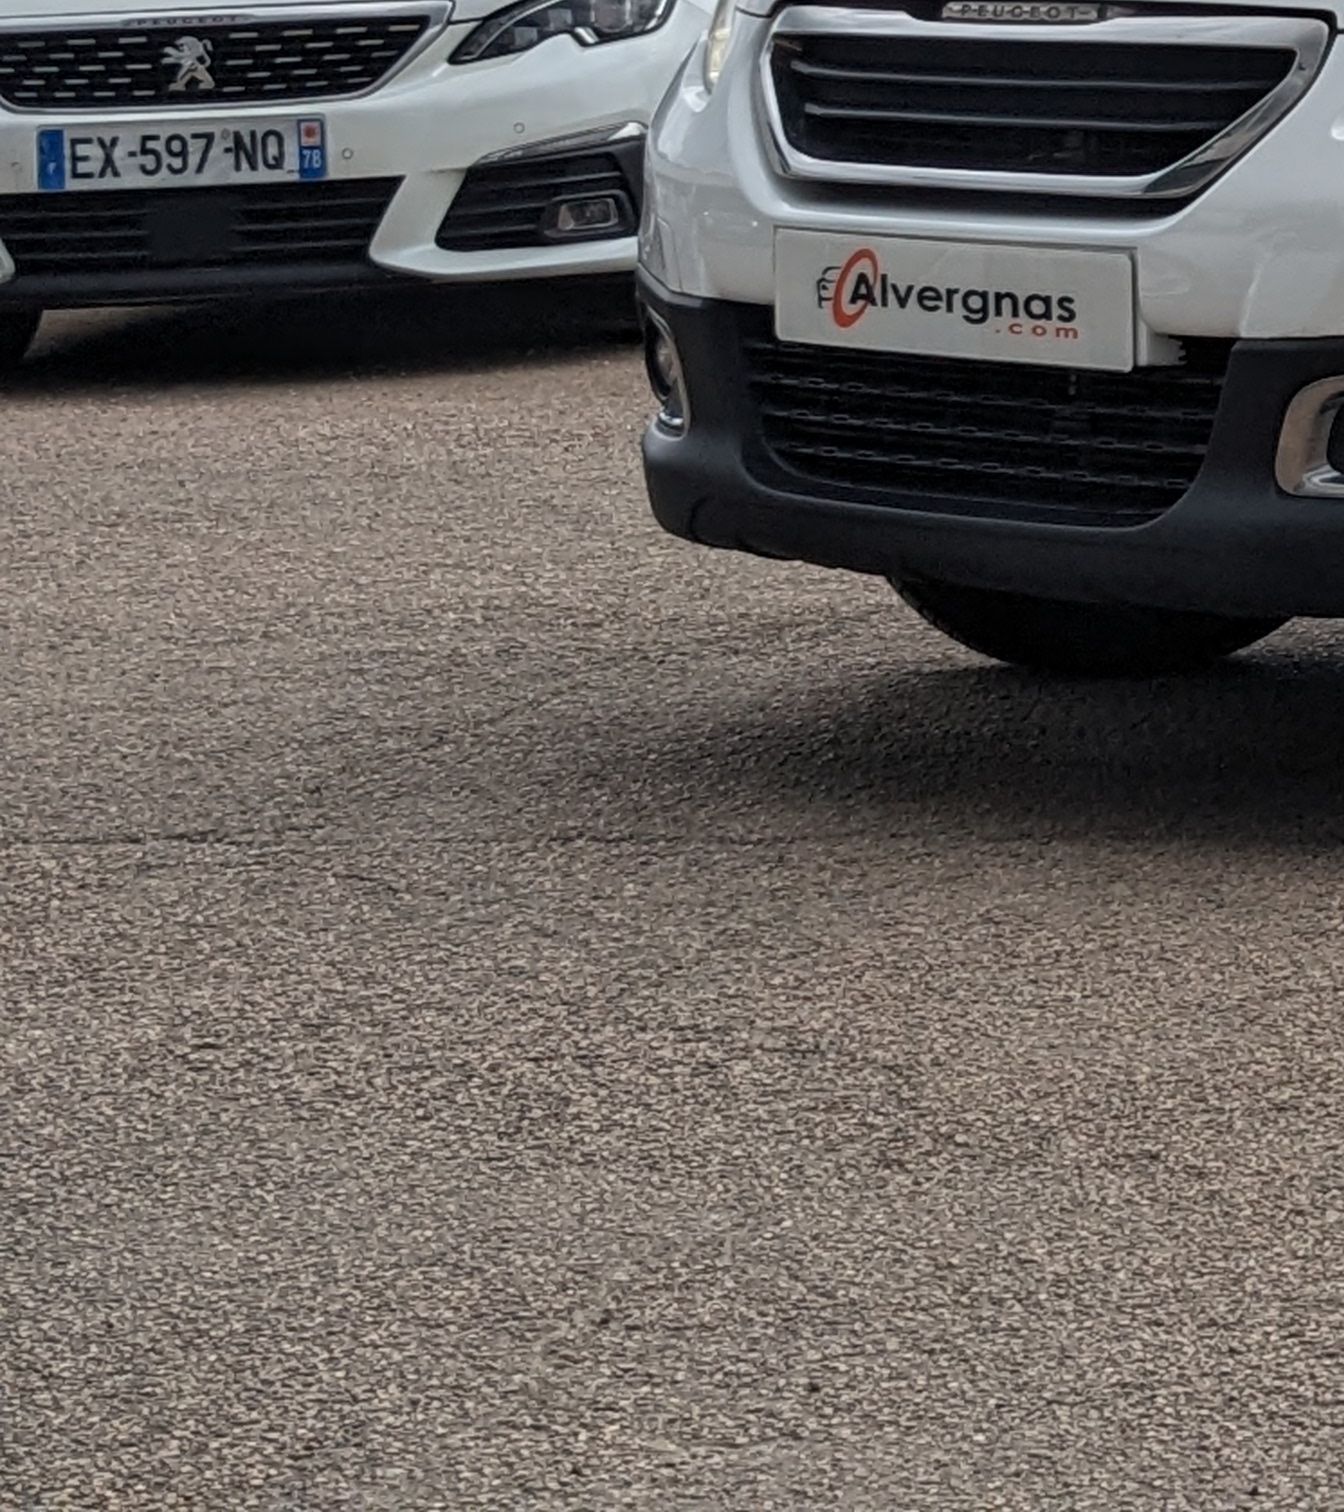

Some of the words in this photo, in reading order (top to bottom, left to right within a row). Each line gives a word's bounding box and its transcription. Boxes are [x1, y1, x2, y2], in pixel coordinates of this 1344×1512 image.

[961, 3, 1079, 19] PEUGEOT
[69, 129, 286, 180] EX-597-NQ
[302, 148, 322, 170] 78
[848, 271, 1078, 325] Alvergnas
[995, 322, 1079, 340] .com
